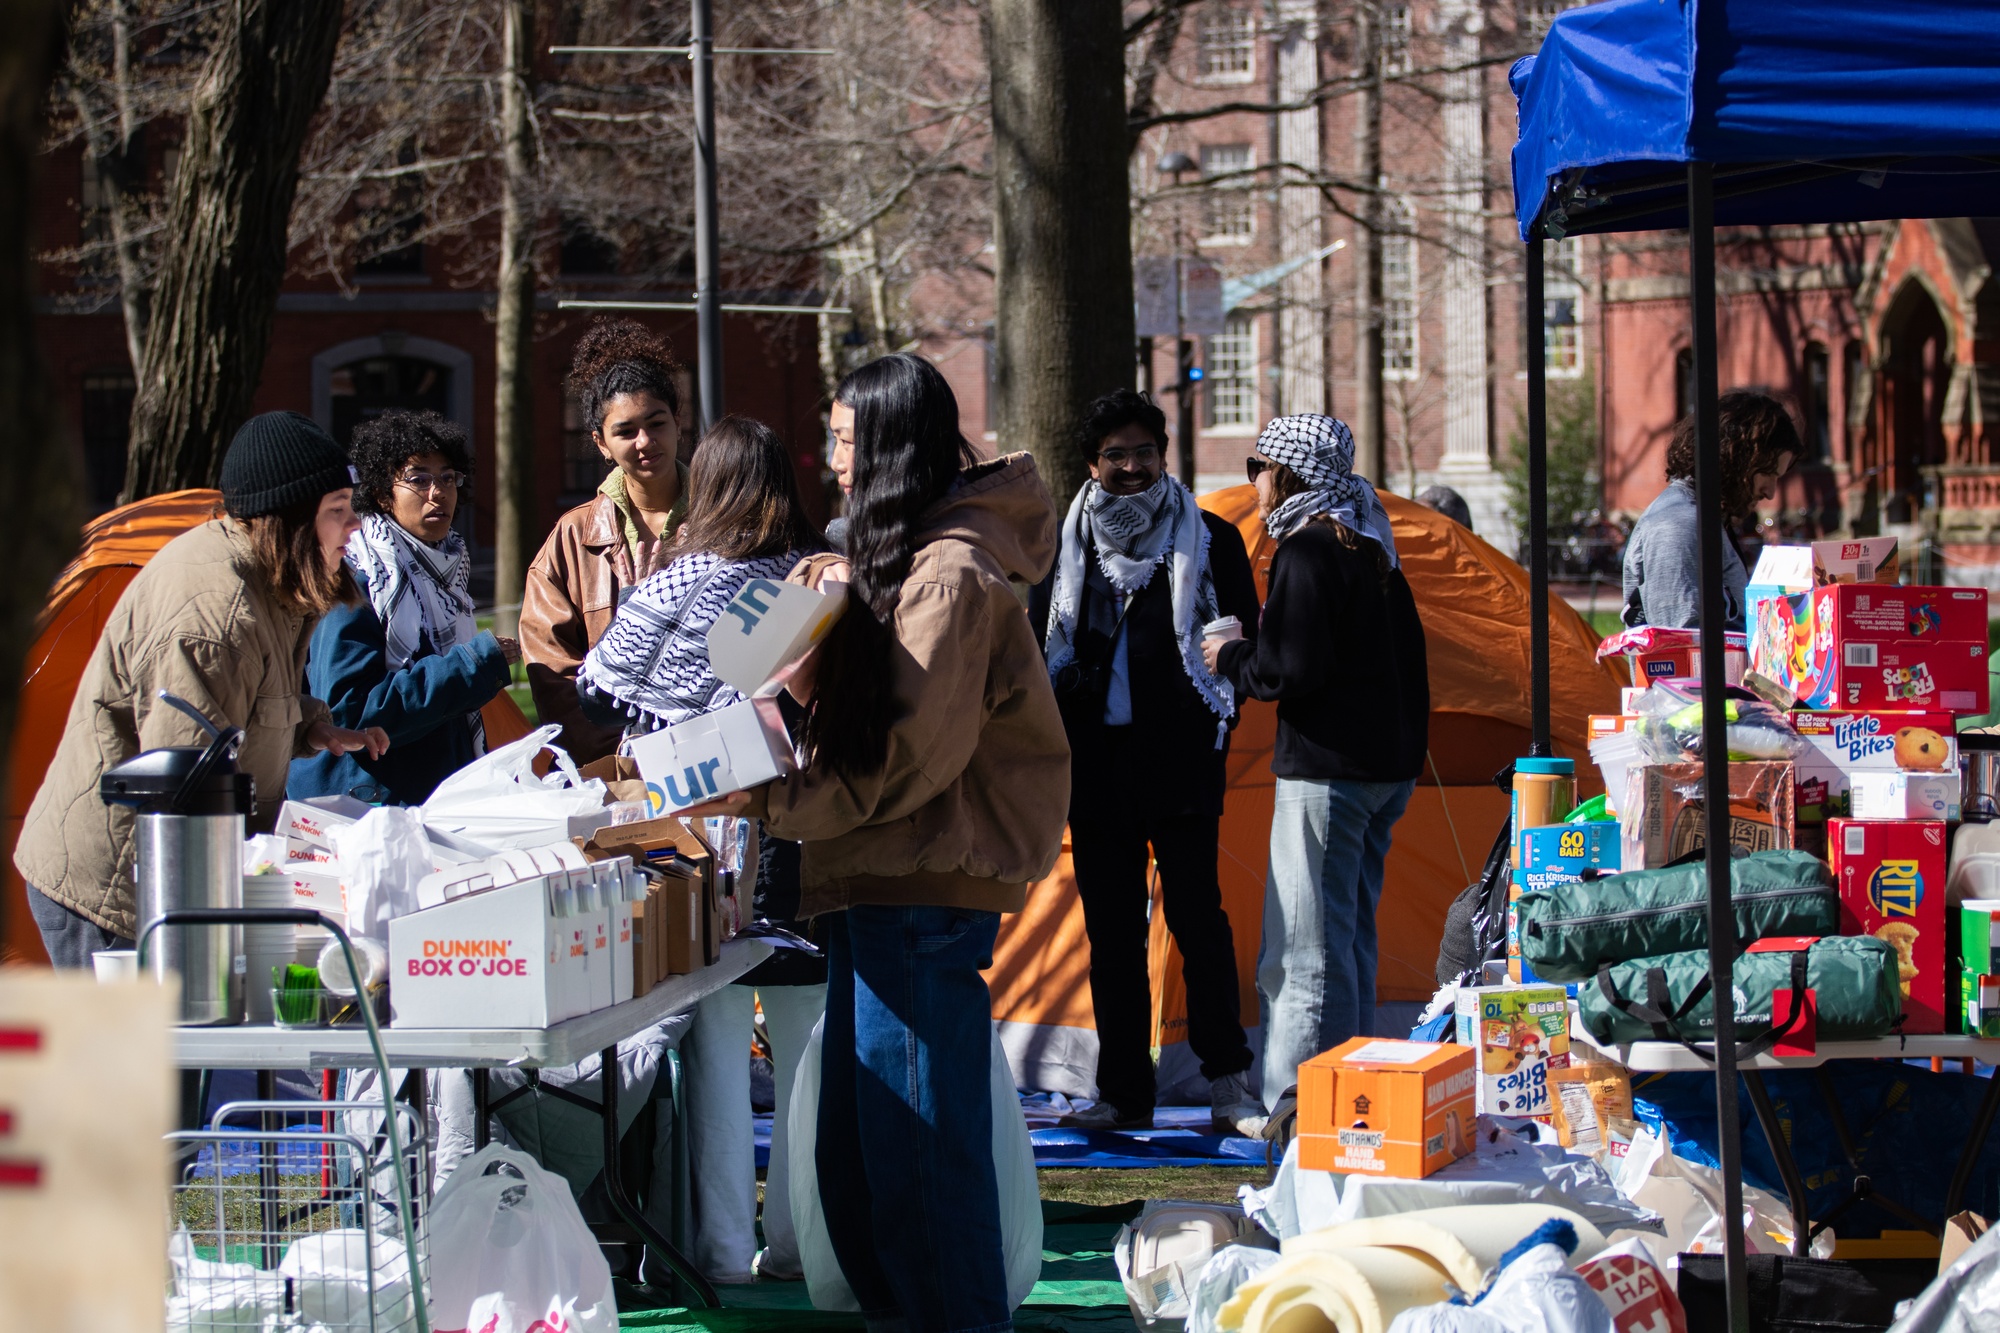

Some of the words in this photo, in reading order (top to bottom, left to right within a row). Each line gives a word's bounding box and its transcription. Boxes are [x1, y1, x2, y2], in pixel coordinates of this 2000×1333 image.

[1650, 664, 1673, 673] LUNA
[1882, 662, 1929, 684] LOOPS
[1885, 675, 1935, 701] FROOT
[1848, 690, 1859, 704] 2
[1797, 714, 1812, 722] 20
[1835, 716, 1879, 748] Little
[1850, 736, 1895, 761] Bites
[291, 821, 323, 837] DUNKIN'
[1560, 831, 1584, 848] 60
[289, 850, 329, 863] DUNKIN'
[1560, 848, 1584, 857] BARS
[1527, 874, 1545, 883] RICE
[1546, 872, 1583, 883] KRISPIES
[1880, 859, 1919, 918] RITZ
[423, 940, 512, 958] DUNKIN'
[408, 959, 453, 976] BOX
[458, 959, 527, 976] O'JOE
[1485, 1003, 1502, 1017] 10
[1734, 1013, 1771, 1024] CROWN
[1497, 1062, 1547, 1092] Bites
[1427, 1080, 1445, 1107] HAND
[1446, 1066, 1475, 1097] WARMERS
[1515, 1084, 1548, 1112] ttle
[1339, 1131, 1382, 1148] HOTHANDS
[1346, 1147, 1375, 1158] HAND
[1334, 1156, 1386, 1171] WARMERS
